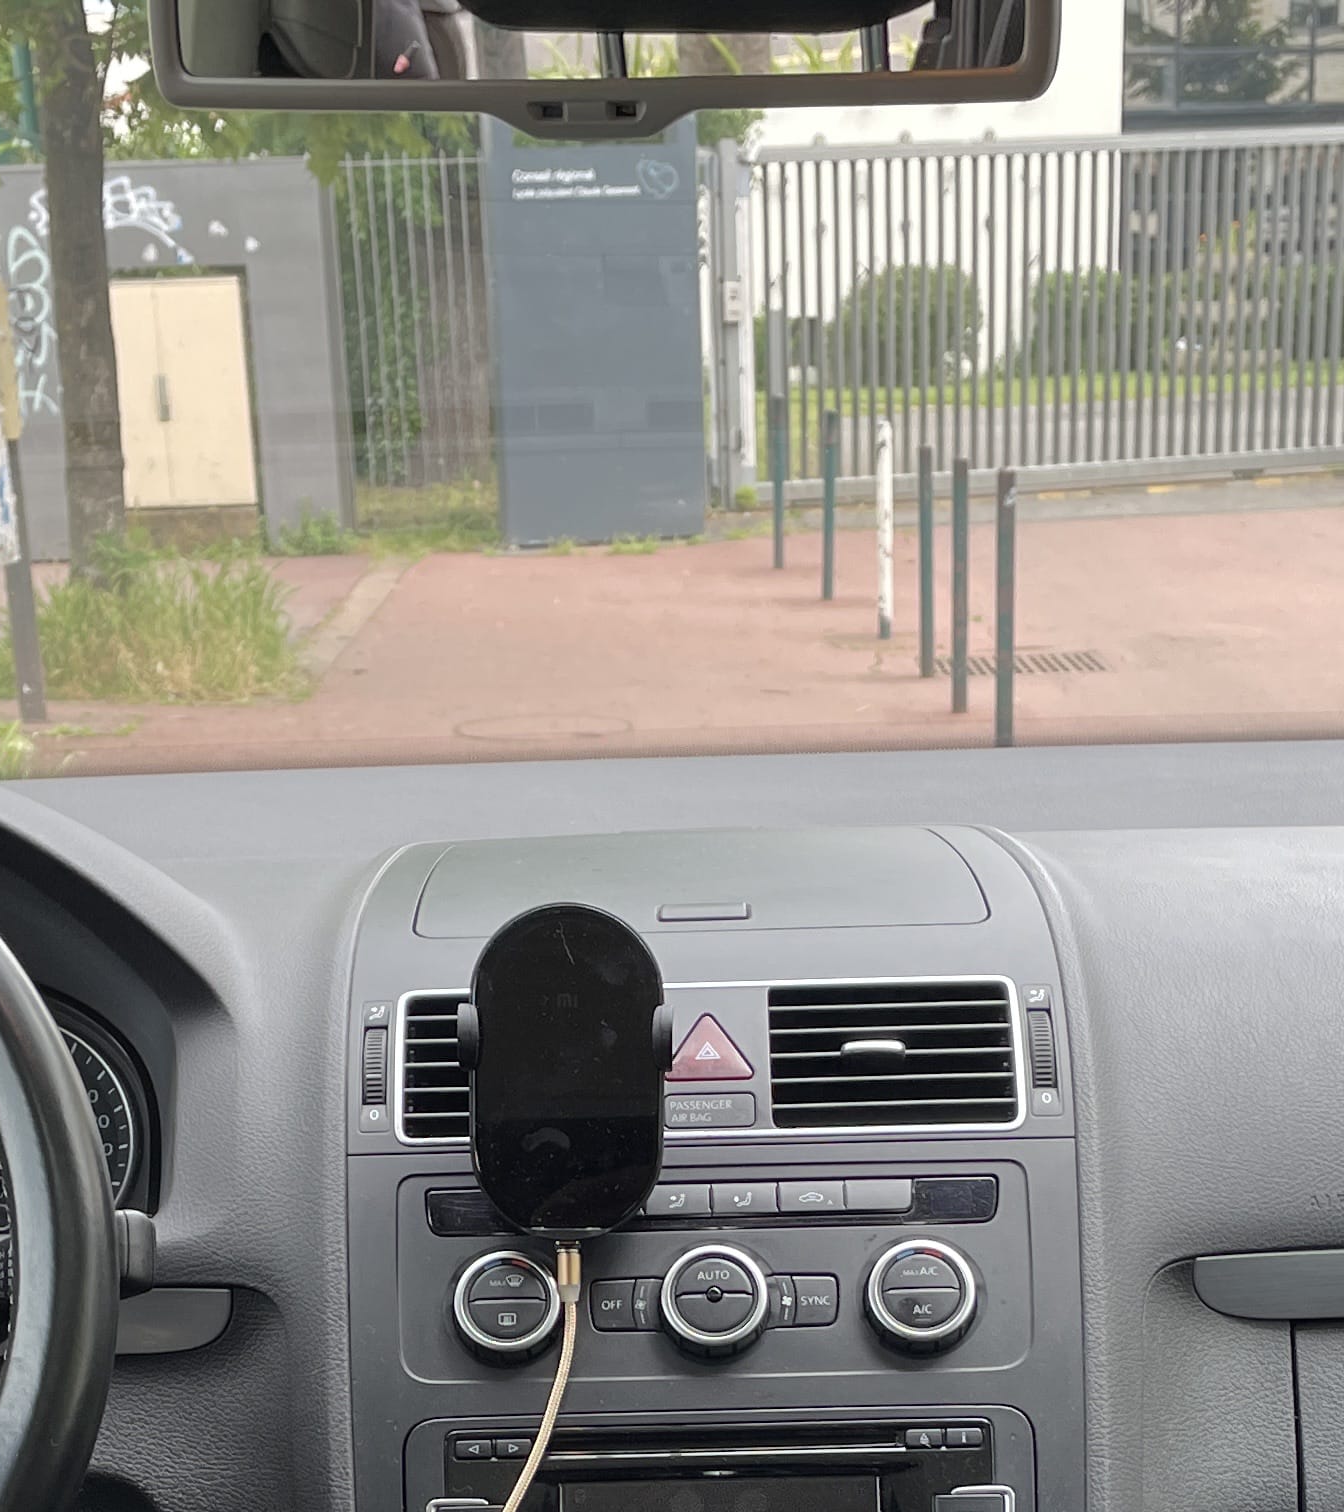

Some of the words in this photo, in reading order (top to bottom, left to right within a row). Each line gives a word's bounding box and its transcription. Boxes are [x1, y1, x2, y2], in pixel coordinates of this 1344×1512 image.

[669, 1099, 733, 1111] PASSENGER
[671, 1113, 688, 1122] AIR
[689, 1112, 712, 1122] BAG
[697, 1270, 730, 1281] AUTO
[919, 1266, 939, 1276] A/C
[601, 1301, 623, 1310] OFF
[800, 1296, 831, 1306] SYNC
[912, 1303, 933, 1315] A/C
